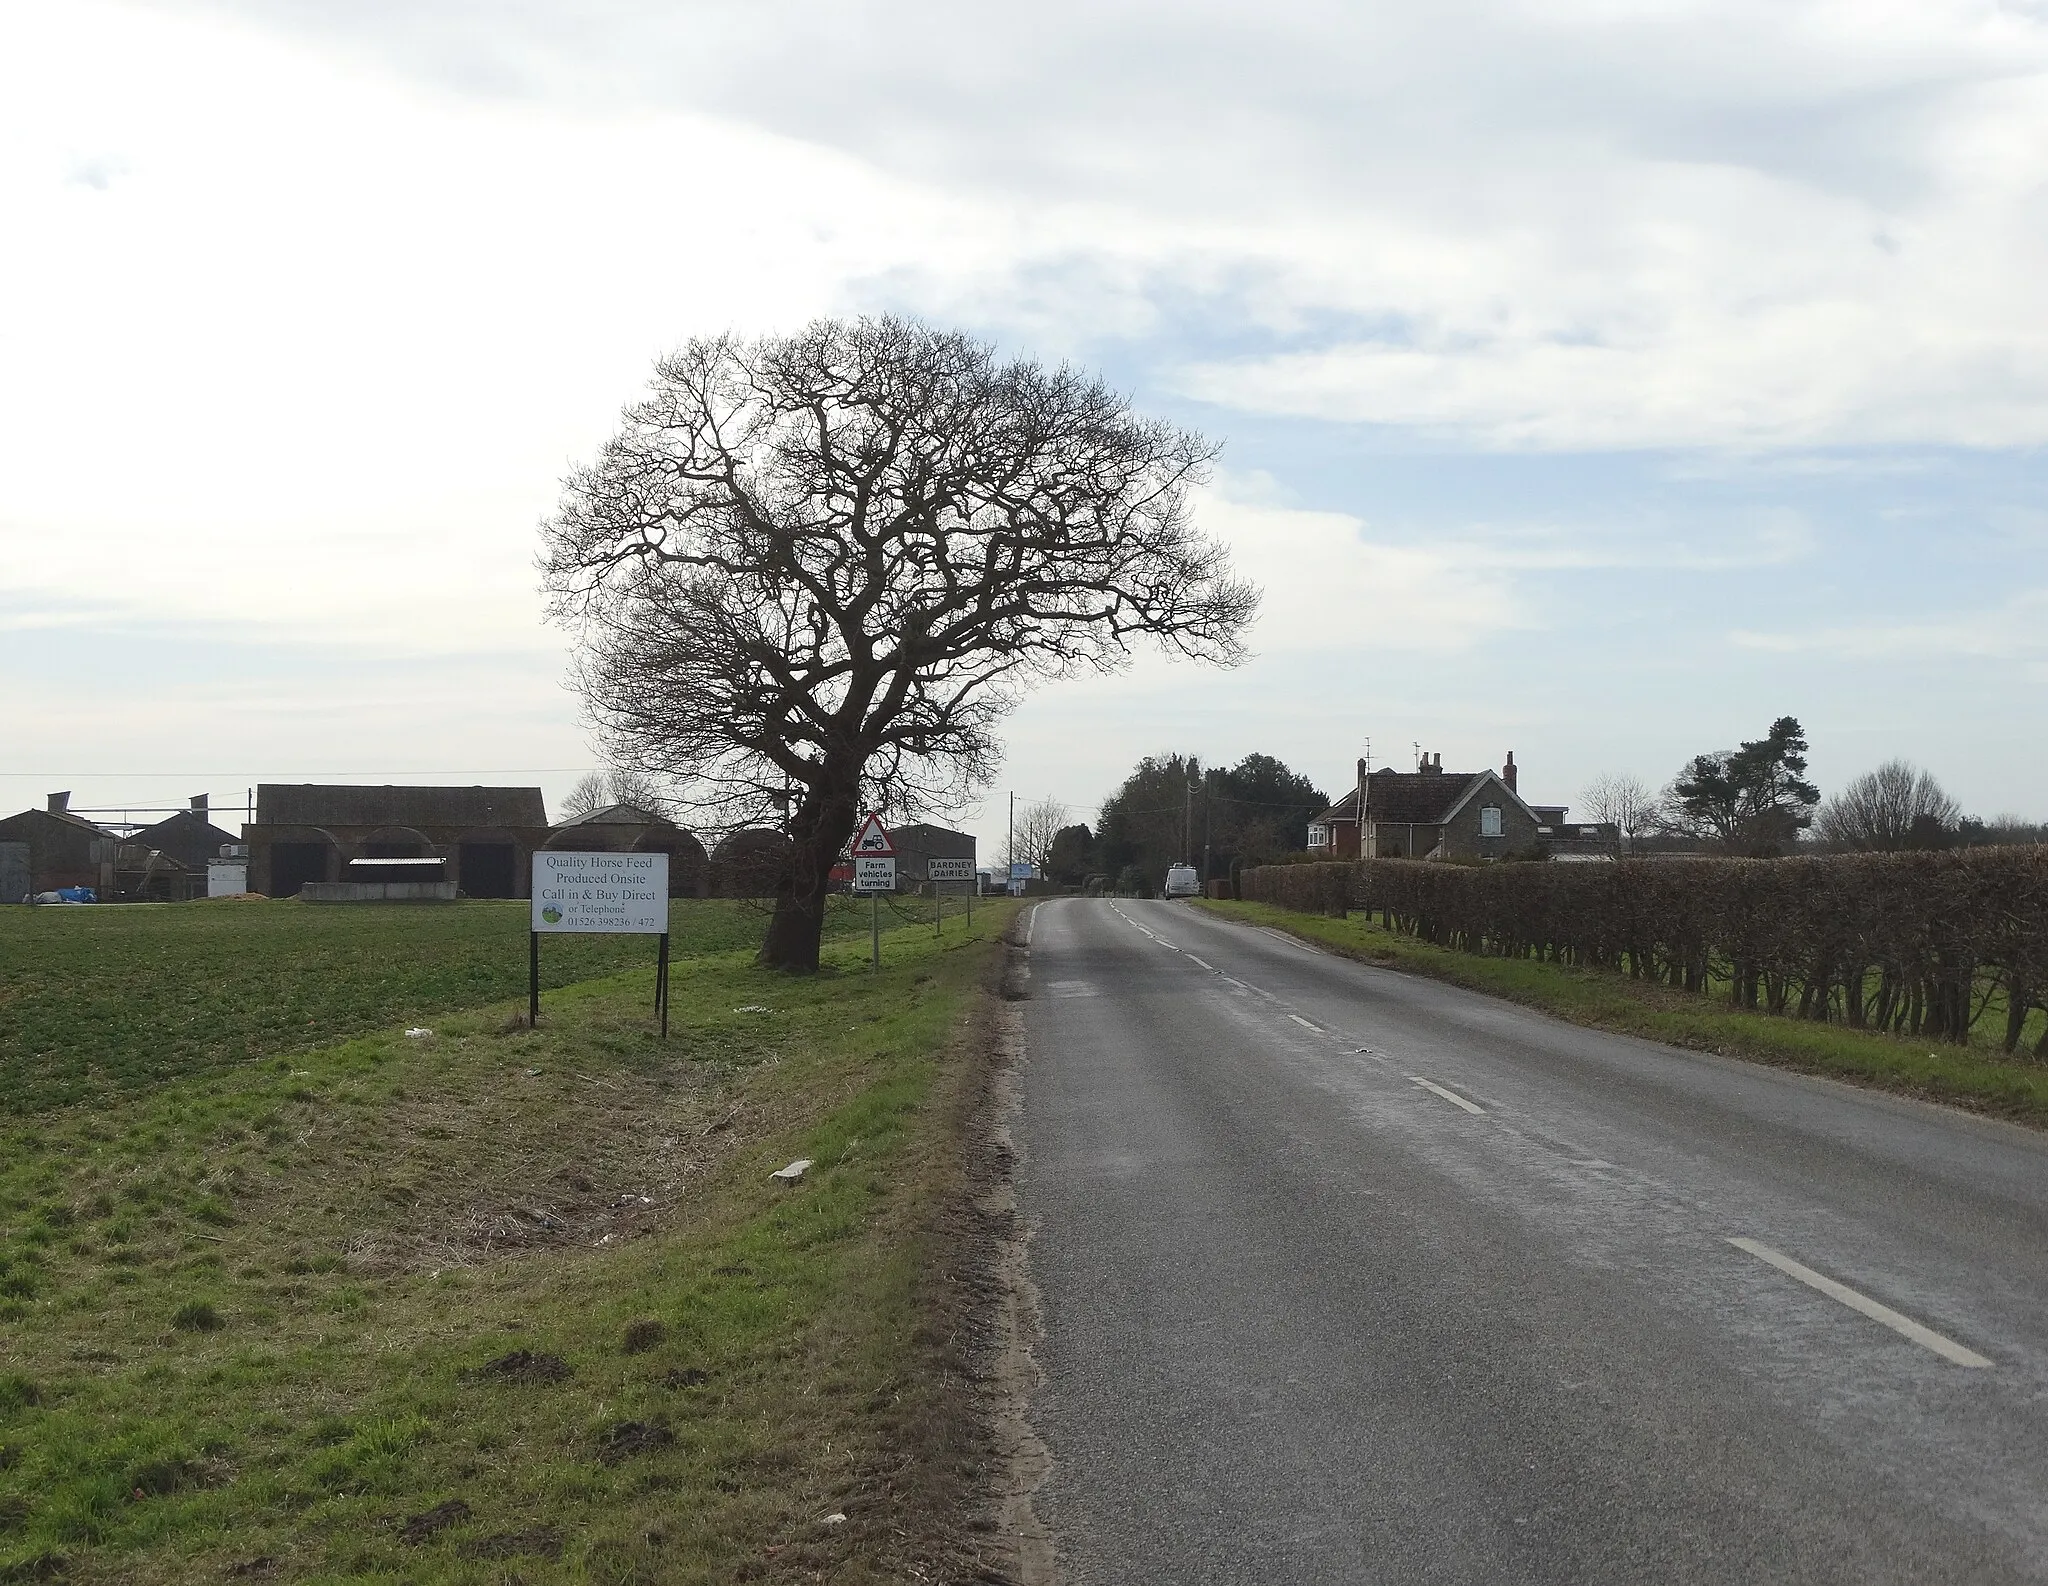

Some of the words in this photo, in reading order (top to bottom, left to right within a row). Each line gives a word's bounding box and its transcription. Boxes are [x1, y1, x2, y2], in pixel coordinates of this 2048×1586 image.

[546, 856, 587, 870] Quality
[591, 857, 623, 868] Horse
[626, 858, 653, 868] Feed
[865, 861, 886, 869] Farm
[930, 861, 972, 869] BARDNEY
[858, 870, 893, 878] vehicles
[934, 869, 969, 877] DAIRIES
[556, 873, 607, 884] Produced
[610, 873, 646, 884] Onsite
[861, 879, 890, 888] turning
[542, 889, 565, 900] Call
[568, 889, 579, 900] in
[582, 889, 592, 900] &
[596, 890, 619, 903] Buy
[622, 890, 656, 900] Direct
[580, 905, 625, 915] Telephone
[567, 918, 596, 927] 01526
[598, 918, 631, 927] 398236
[638, 918, 655, 927] 472
